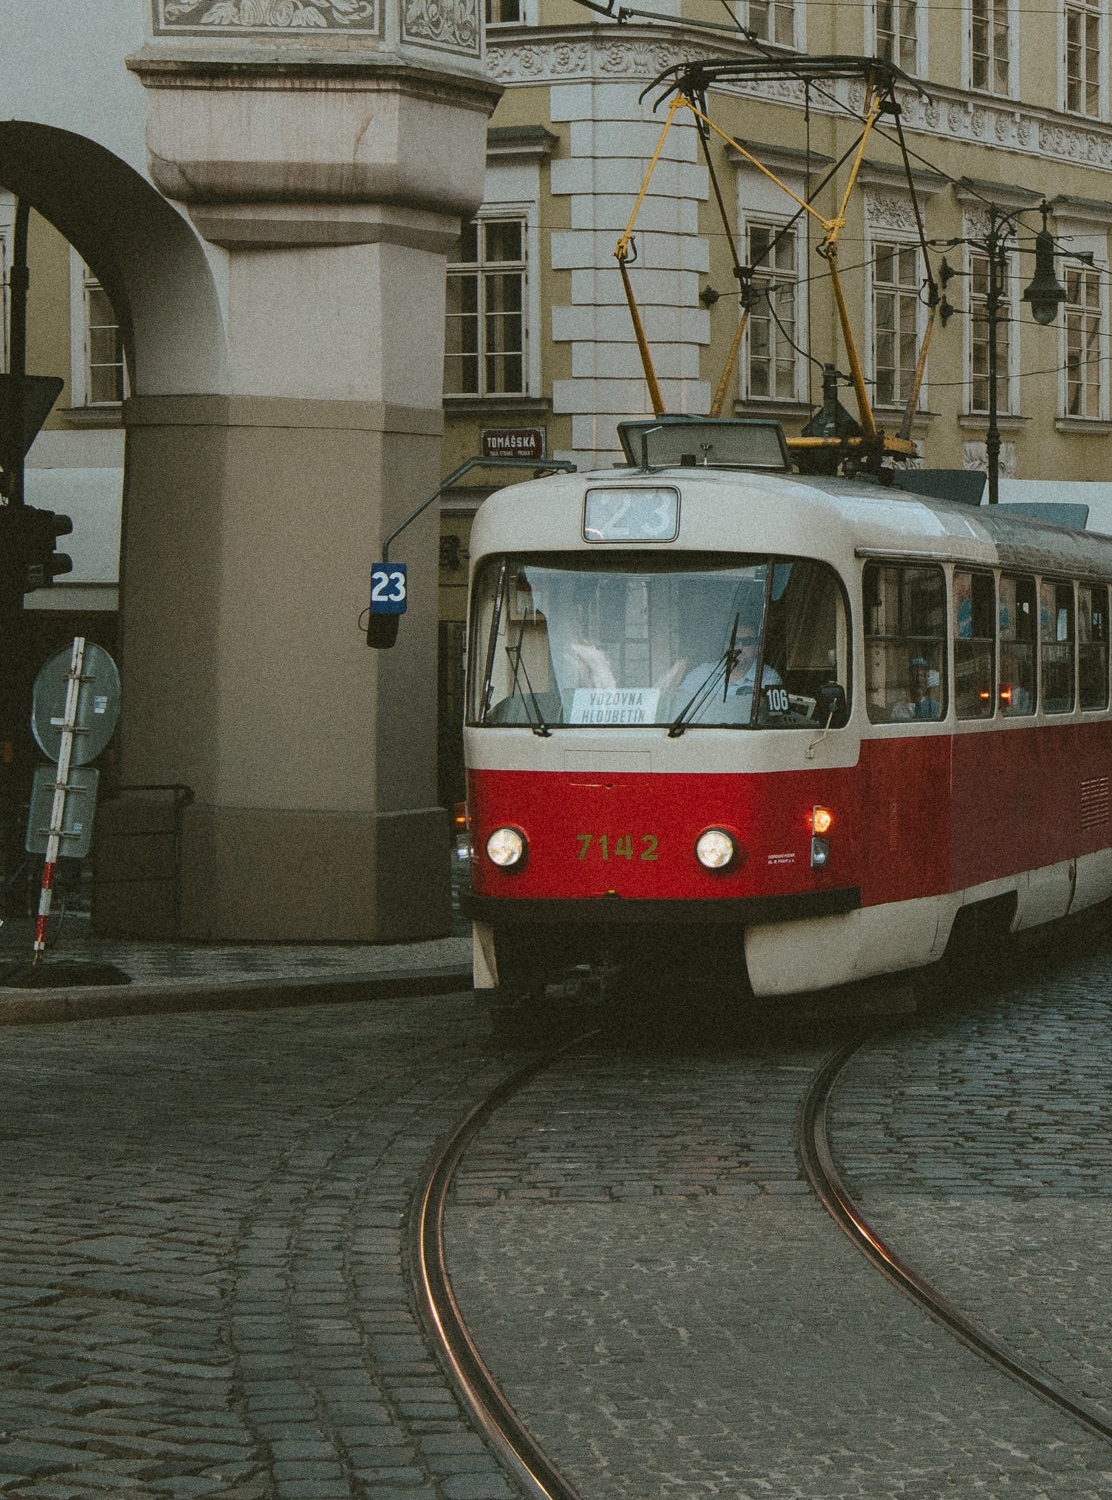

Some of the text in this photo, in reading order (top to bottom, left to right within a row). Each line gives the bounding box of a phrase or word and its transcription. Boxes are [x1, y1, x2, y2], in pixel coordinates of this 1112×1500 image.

[487, 434, 536, 448] TOMÁŠSKÁ
[600, 493, 672, 536] 23
[372, 571, 406, 602] 23
[590, 692, 643, 706] VOZOVNA
[766, 689, 788, 711] 106
[576, 834, 659, 861] 7142
